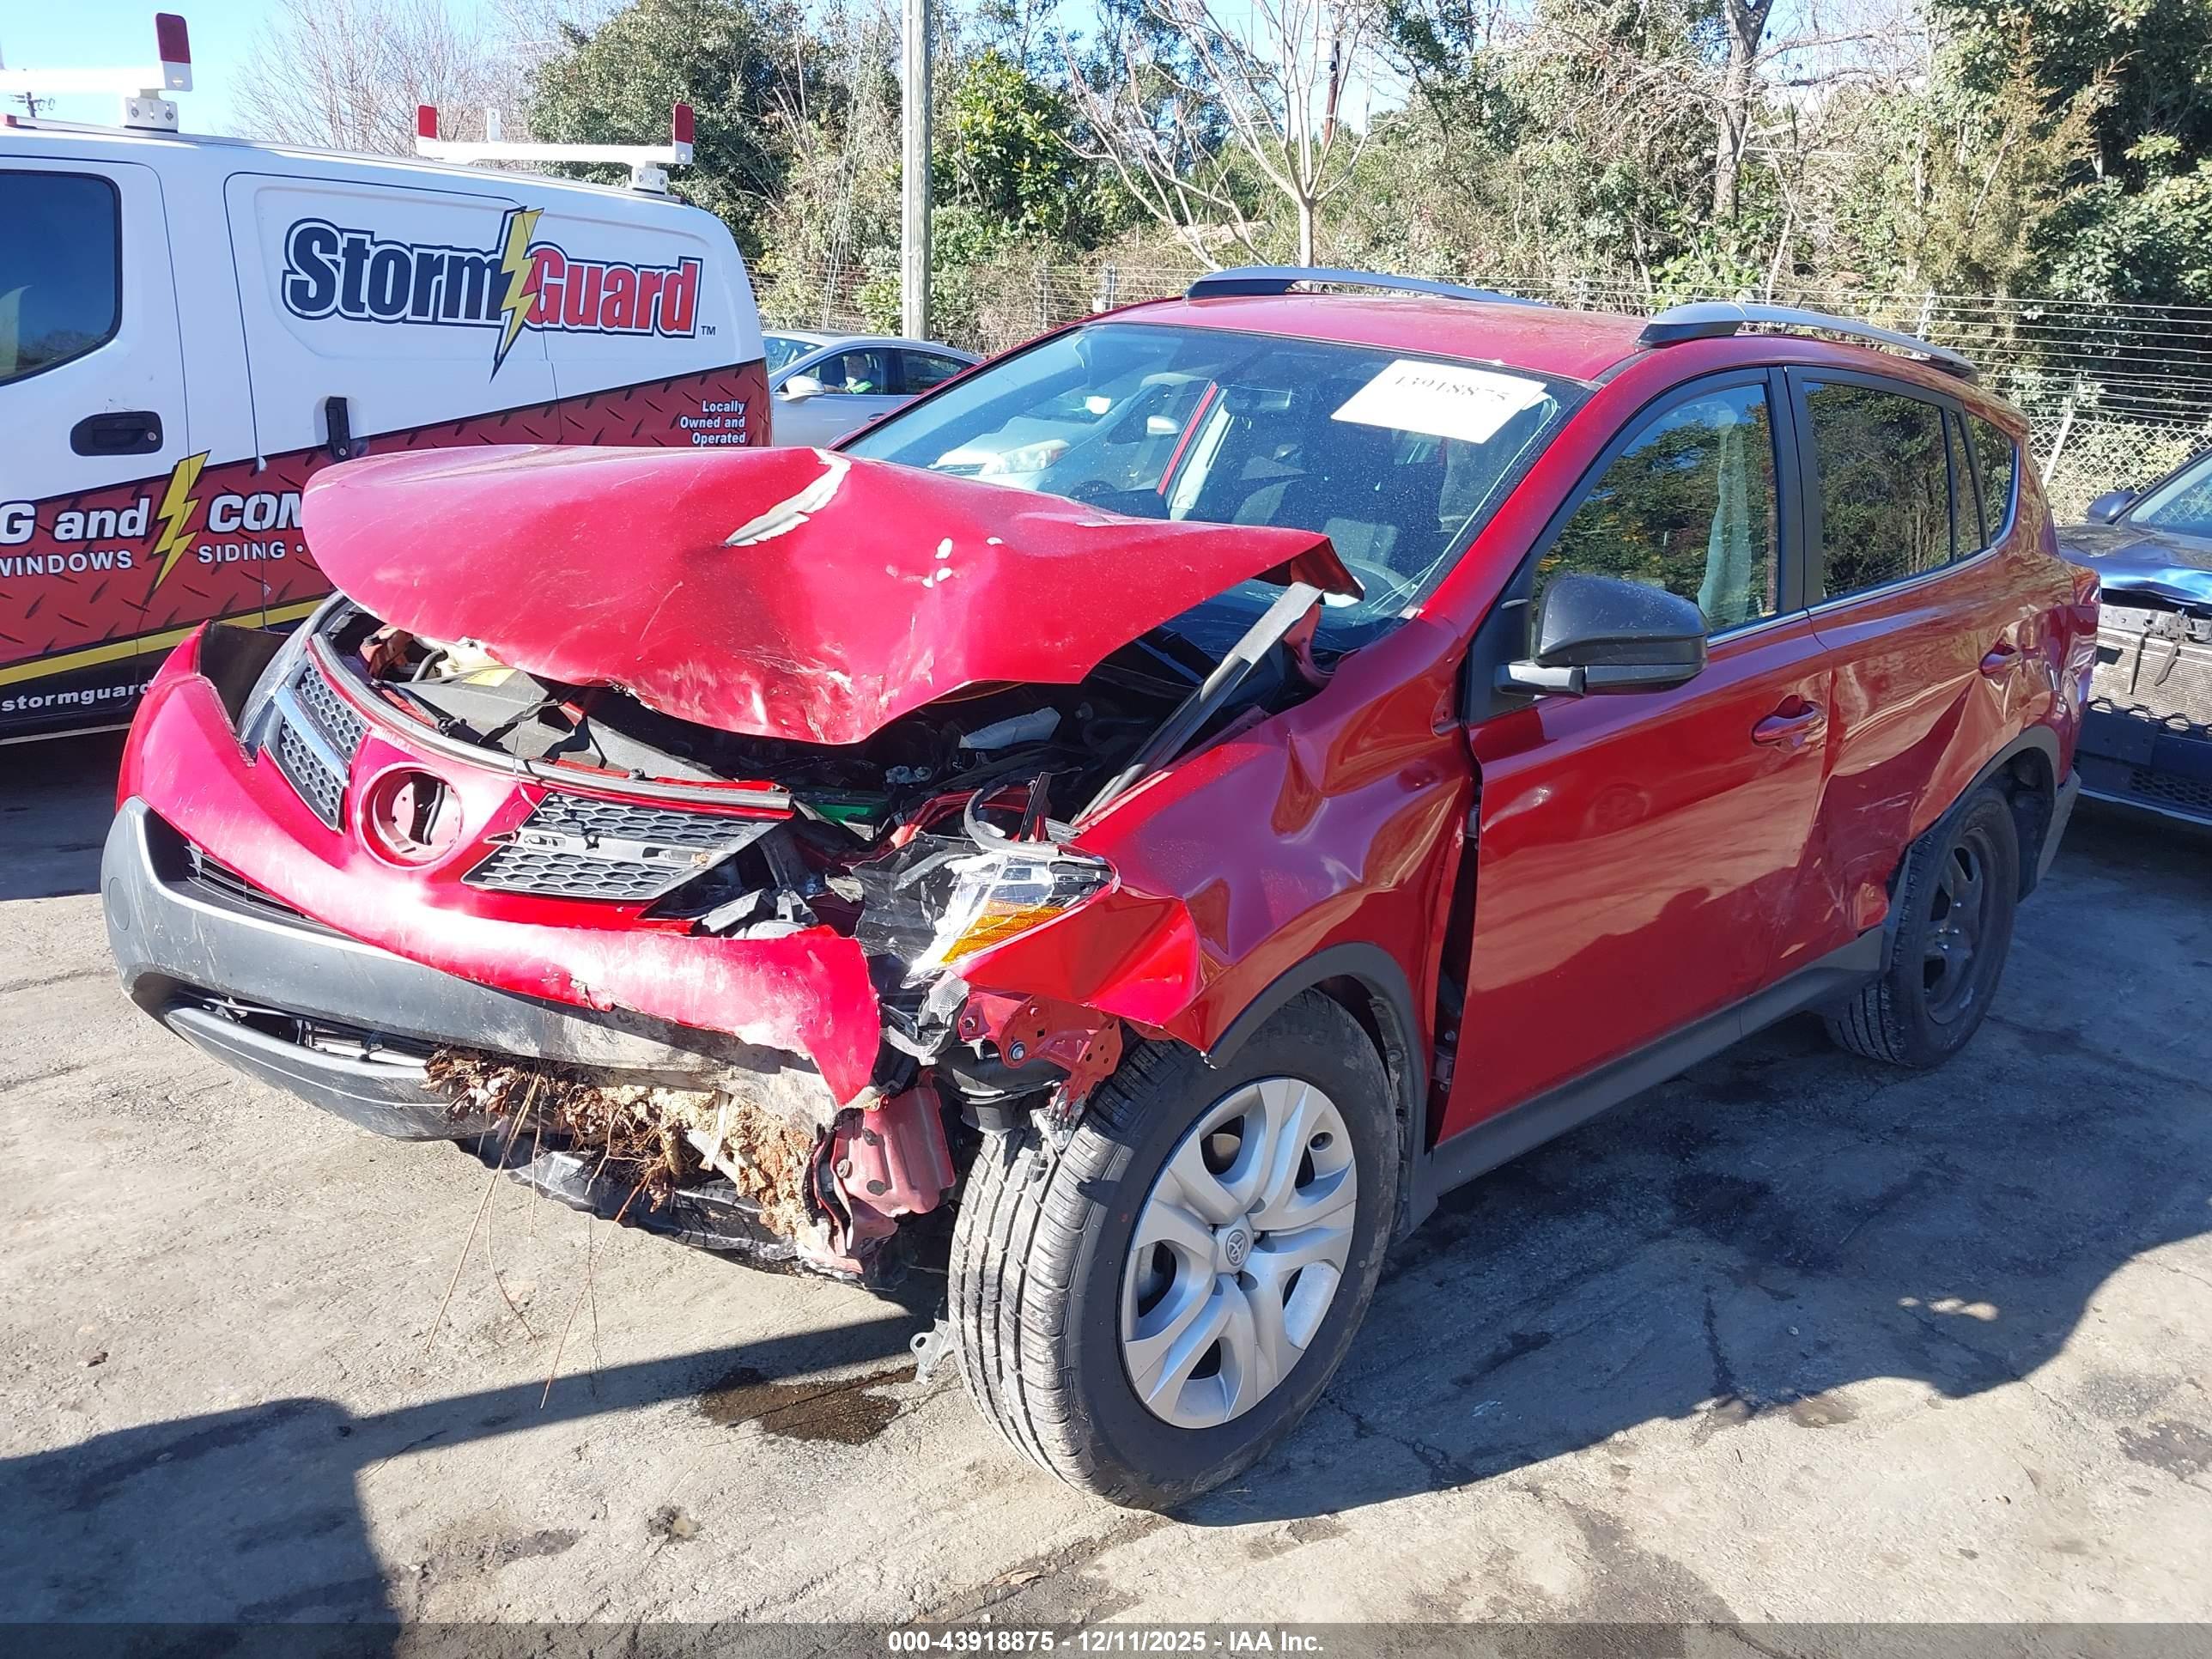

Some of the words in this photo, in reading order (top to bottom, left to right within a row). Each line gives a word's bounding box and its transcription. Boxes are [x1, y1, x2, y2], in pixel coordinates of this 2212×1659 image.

[702, 400, 744, 415] Locally
[680, 416, 720, 428] Owned
[725, 416, 745, 428] and
[692, 432, 746, 447] Operated
[54, 497, 150, 541] and
[198, 541, 286, 563] SIDING
